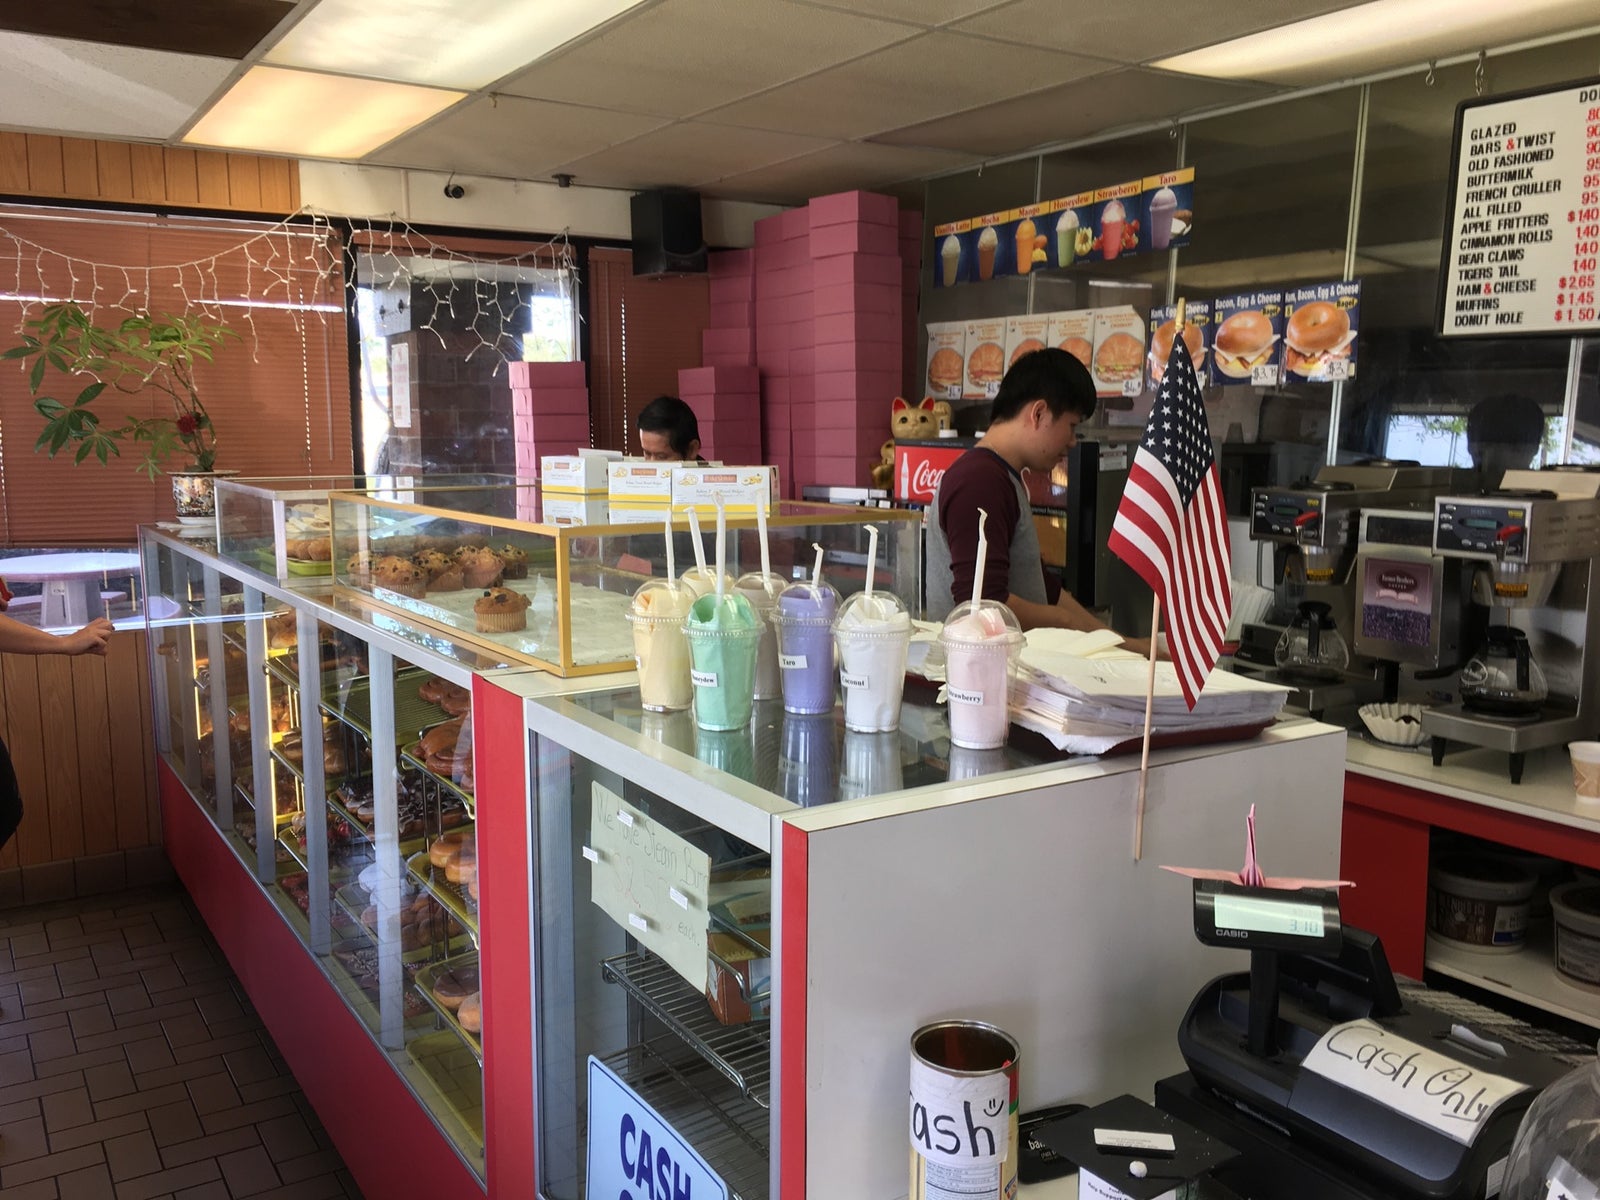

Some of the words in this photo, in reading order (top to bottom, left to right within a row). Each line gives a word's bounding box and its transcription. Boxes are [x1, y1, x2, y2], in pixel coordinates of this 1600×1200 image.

[1579, 88, 1600, 103] DO
[1471, 122, 1517, 141] GLAZED
[1470, 141, 1502, 156] BARS
[1468, 158, 1489, 173] OLD
[1493, 148, 1554, 169] FASHIONED
[1159, 174, 1177, 185] Taro
[1467, 167, 1534, 188] BUTTERMILK
[1096, 183, 1139, 199] Strawberry
[1465, 186, 1507, 203] FRENCH
[1512, 178, 1562, 197] CRULLER
[1019, 206, 1040, 217] Mango
[1053, 195, 1090, 210] Honeydew
[1463, 205, 1481, 220] ALL
[1486, 200, 1522, 216] FILLED
[1460, 220, 1492, 235] APPLE
[1497, 213, 1549, 231] FRITTERS
[1460, 232, 1515, 251] CINNAMON
[1518, 229, 1553, 244] ROLLS
[1458, 252, 1484, 266] BEAR
[1488, 248, 1525, 263] CLAWS
[1458, 267, 1493, 281] TIGERS
[1498, 265, 1520, 278] TAIL
[1297, 289, 1317, 301] Bacon,
[1317, 286, 1329, 300] Egg
[1336, 283, 1359, 296] Cheese
[1456, 283, 1482, 297] HAM
[1493, 279, 1537, 294] CHEESE
[1215, 298, 1236, 310] Bacon,
[1236, 295, 1249, 309] Egg
[1257, 292, 1282, 305] Cheese
[1455, 298, 1500, 312] MUFFINS
[1454, 314, 1490, 327] DONUT
[1495, 311, 1524, 325] HOLE
[1215, 928, 1249, 939] CASIO
[1326, 1024, 1422, 1089] Cash
[1424, 1066, 1490, 1123] Only
[910, 1096, 996, 1158] ash
